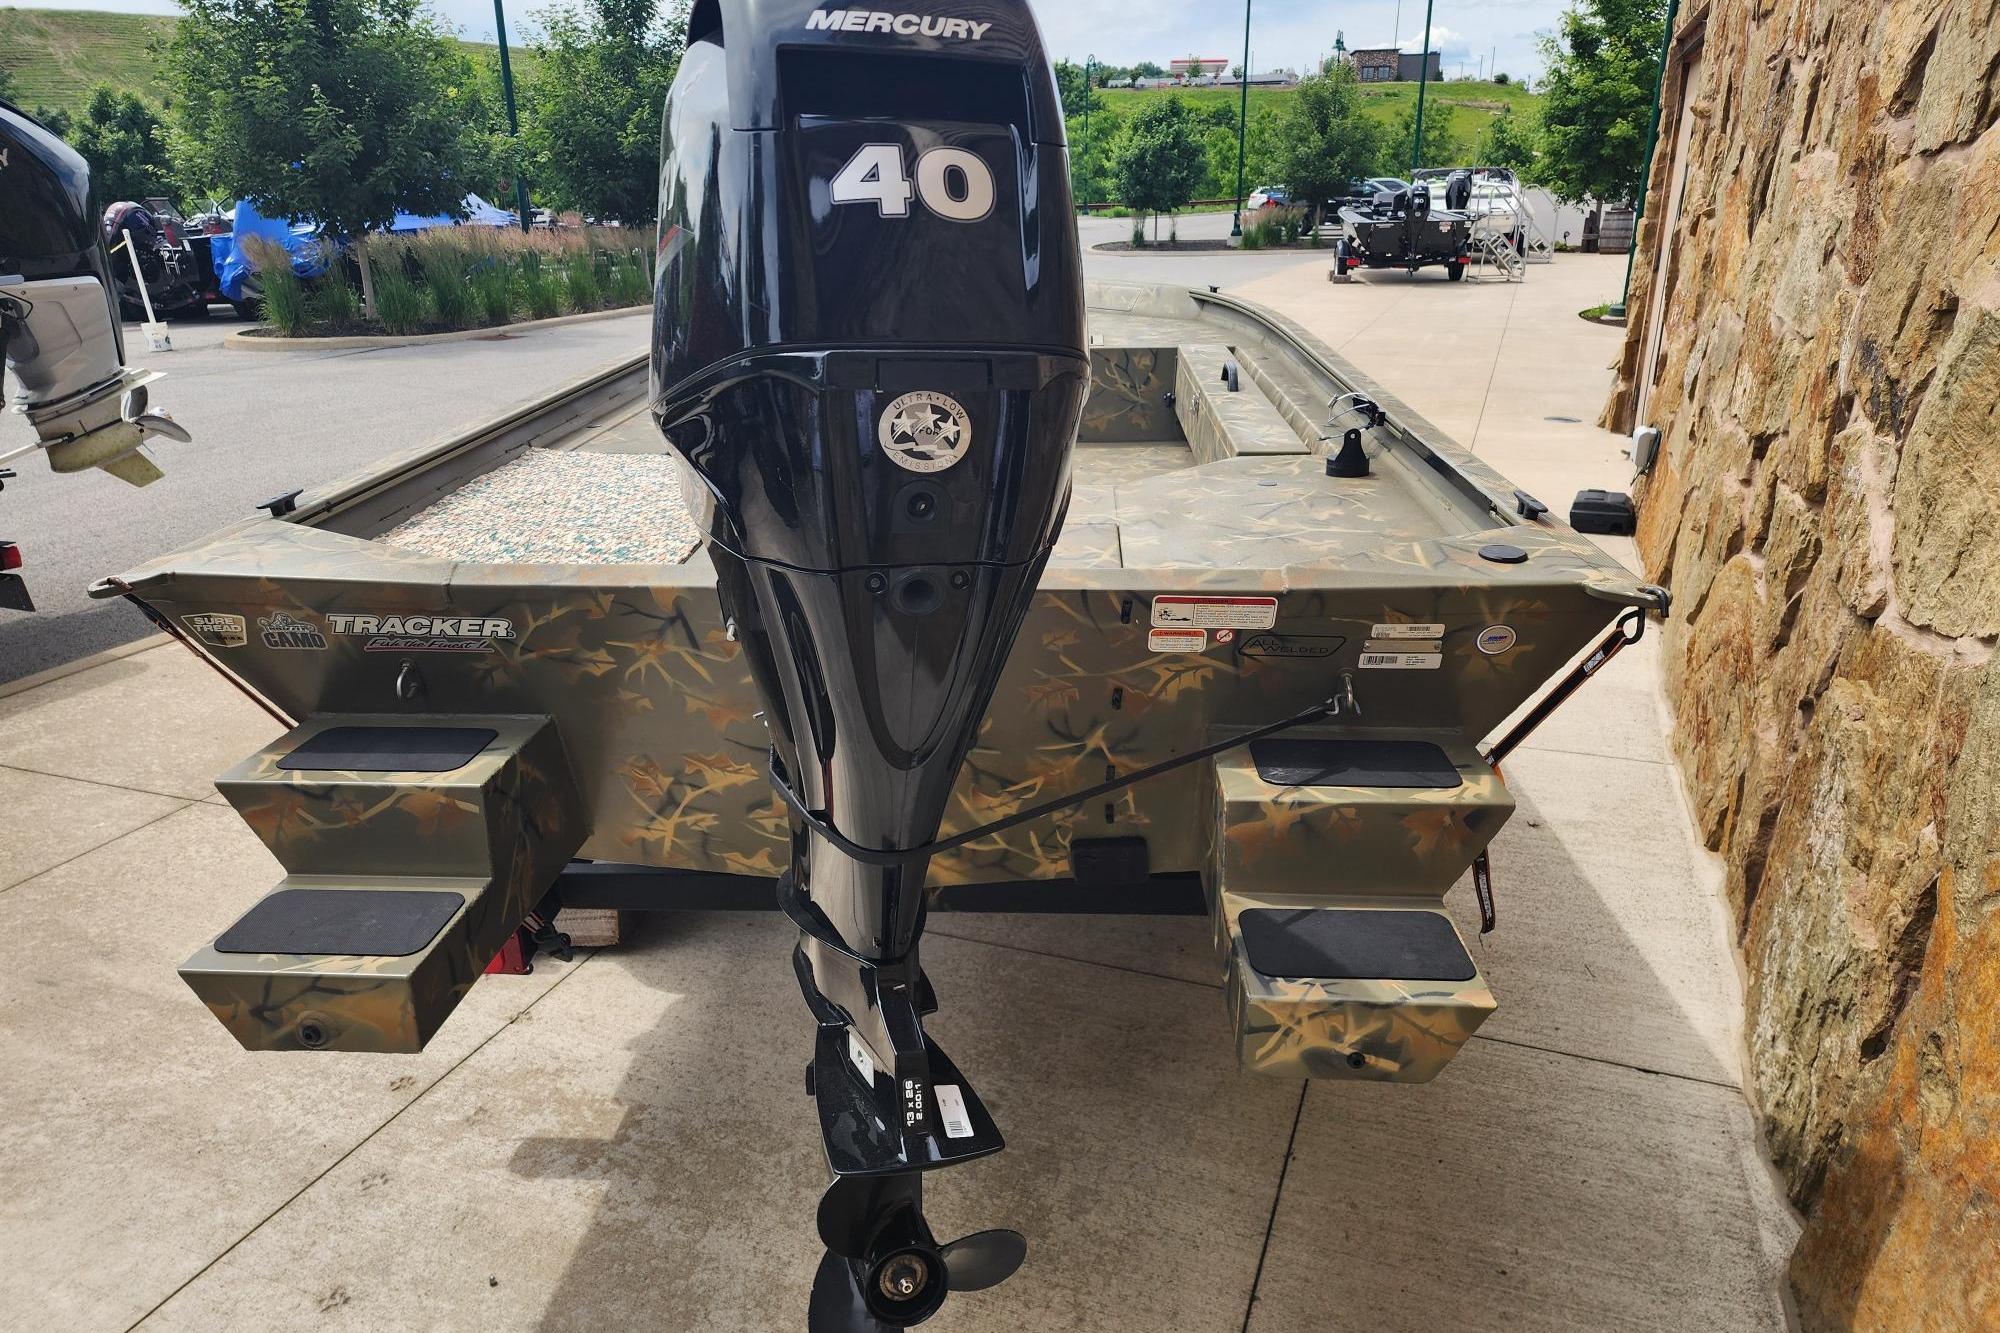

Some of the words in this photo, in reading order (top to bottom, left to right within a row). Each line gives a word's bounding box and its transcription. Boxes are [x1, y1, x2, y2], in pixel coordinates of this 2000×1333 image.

[805, 9, 992, 40] MERCURY
[829, 143, 997, 223] 40
[893, 393, 933, 410] ULTRA
[942, 398, 966, 420] LOW
[193, 624, 242, 632] TREAD
[194, 617, 235, 625] SURE
[327, 615, 510, 637] TRACKER
[265, 632, 325, 648] CAMO
[1249, 639, 1280, 651] ALL
[906, 1111, 915, 1127] 13
